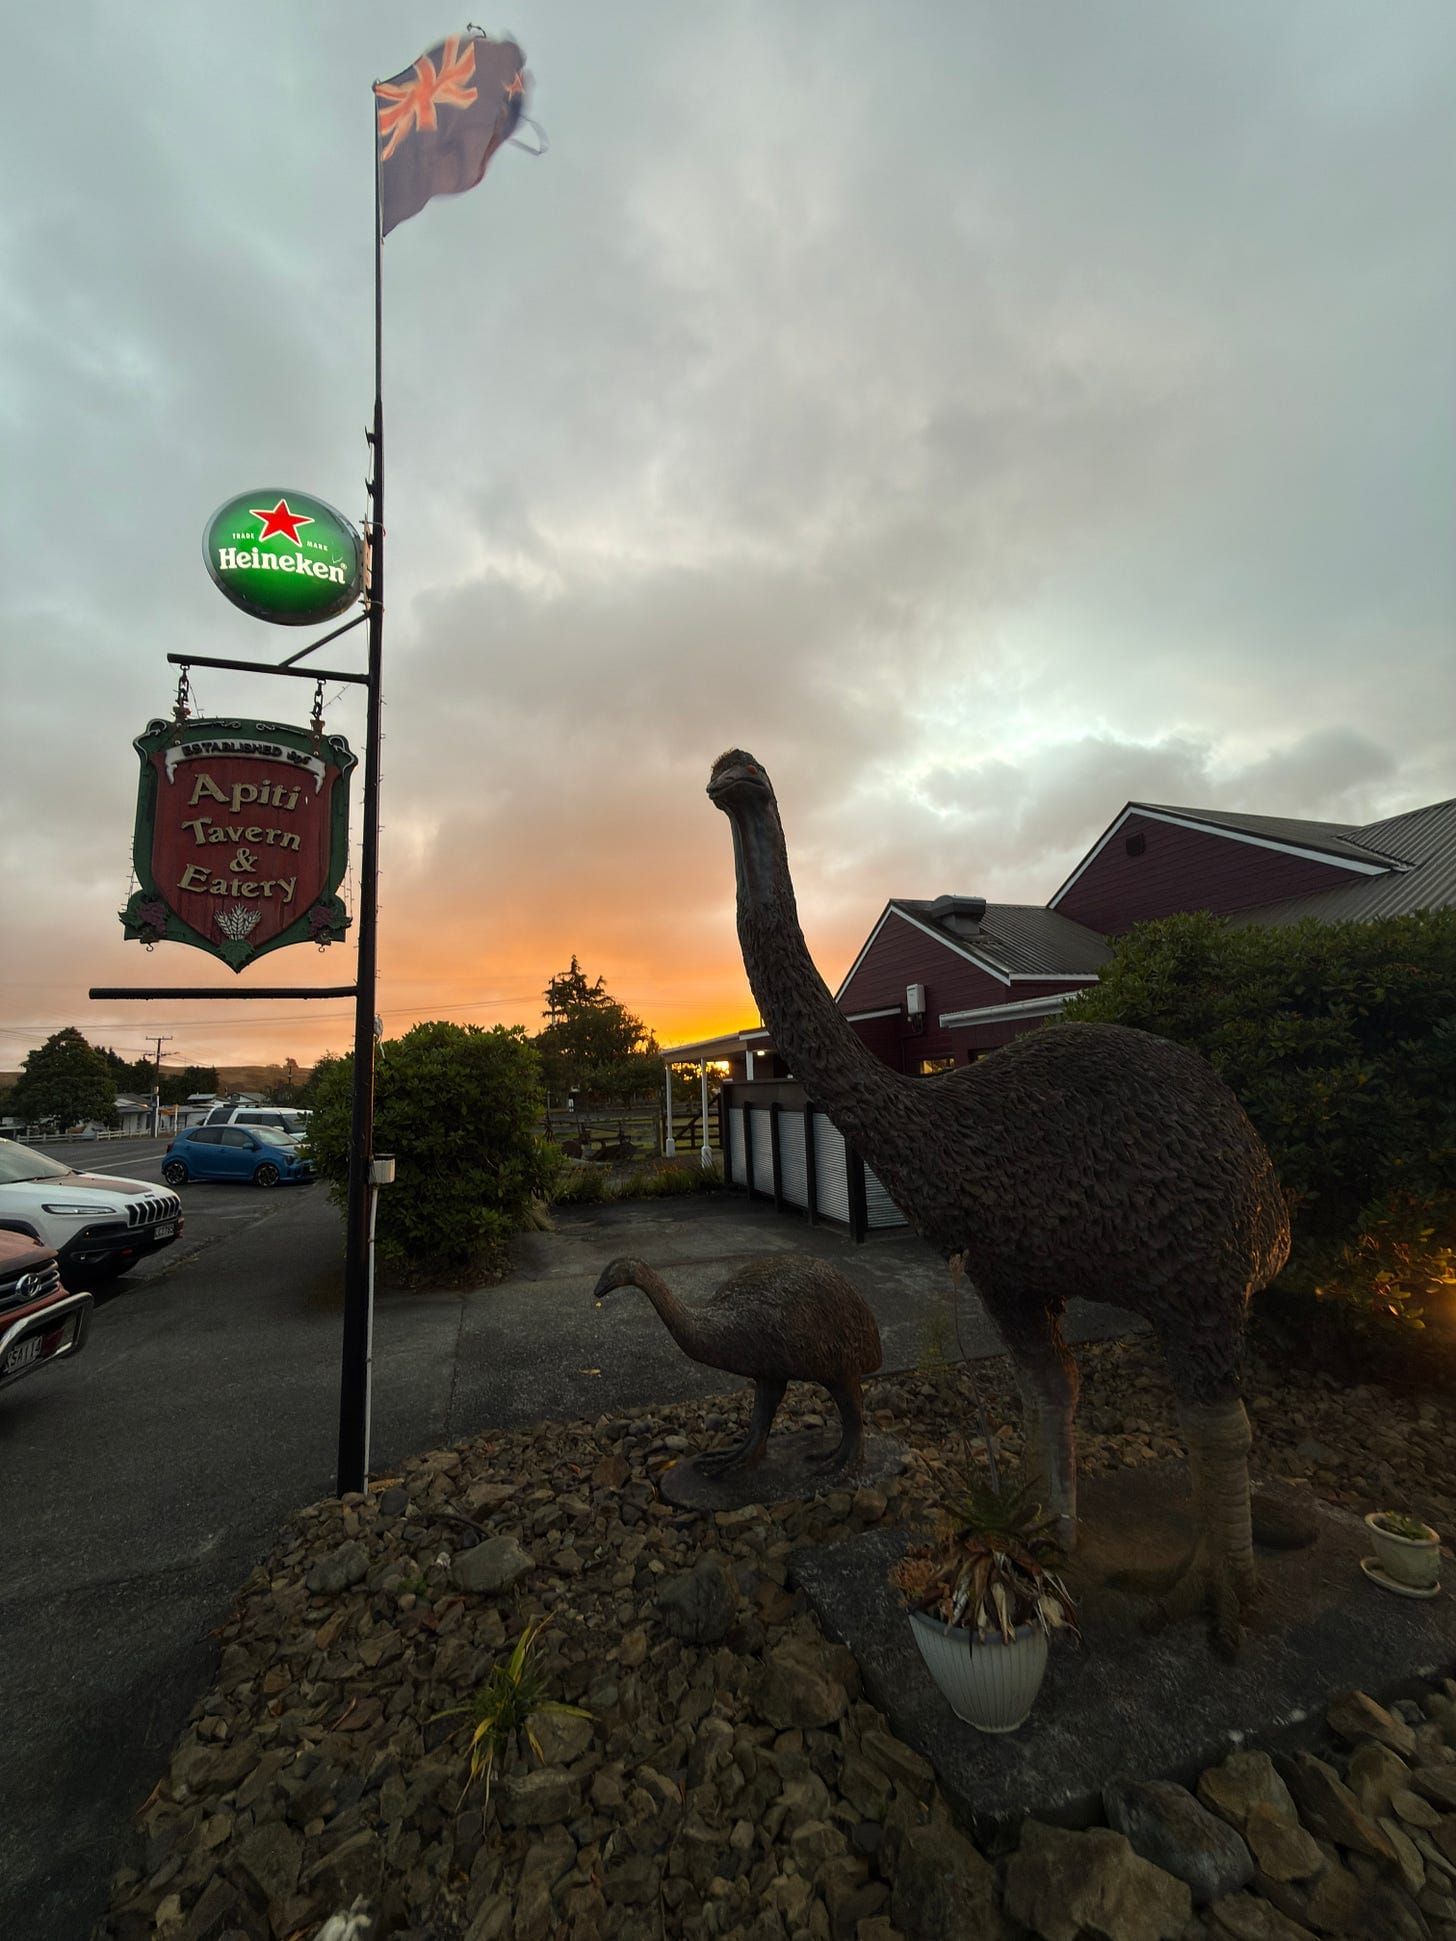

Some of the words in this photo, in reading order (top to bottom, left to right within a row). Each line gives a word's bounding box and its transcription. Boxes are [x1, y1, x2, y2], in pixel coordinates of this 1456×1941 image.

[306, 541, 328, 552] MARK
[218, 547, 346, 584] Heineken
[181, 741, 282, 757] ESTABLISHED
[187, 773, 302, 813] Apiti
[181, 816, 300, 851] Tavern
[229, 847, 259, 873] &
[177, 863, 297, 903] Eatery
